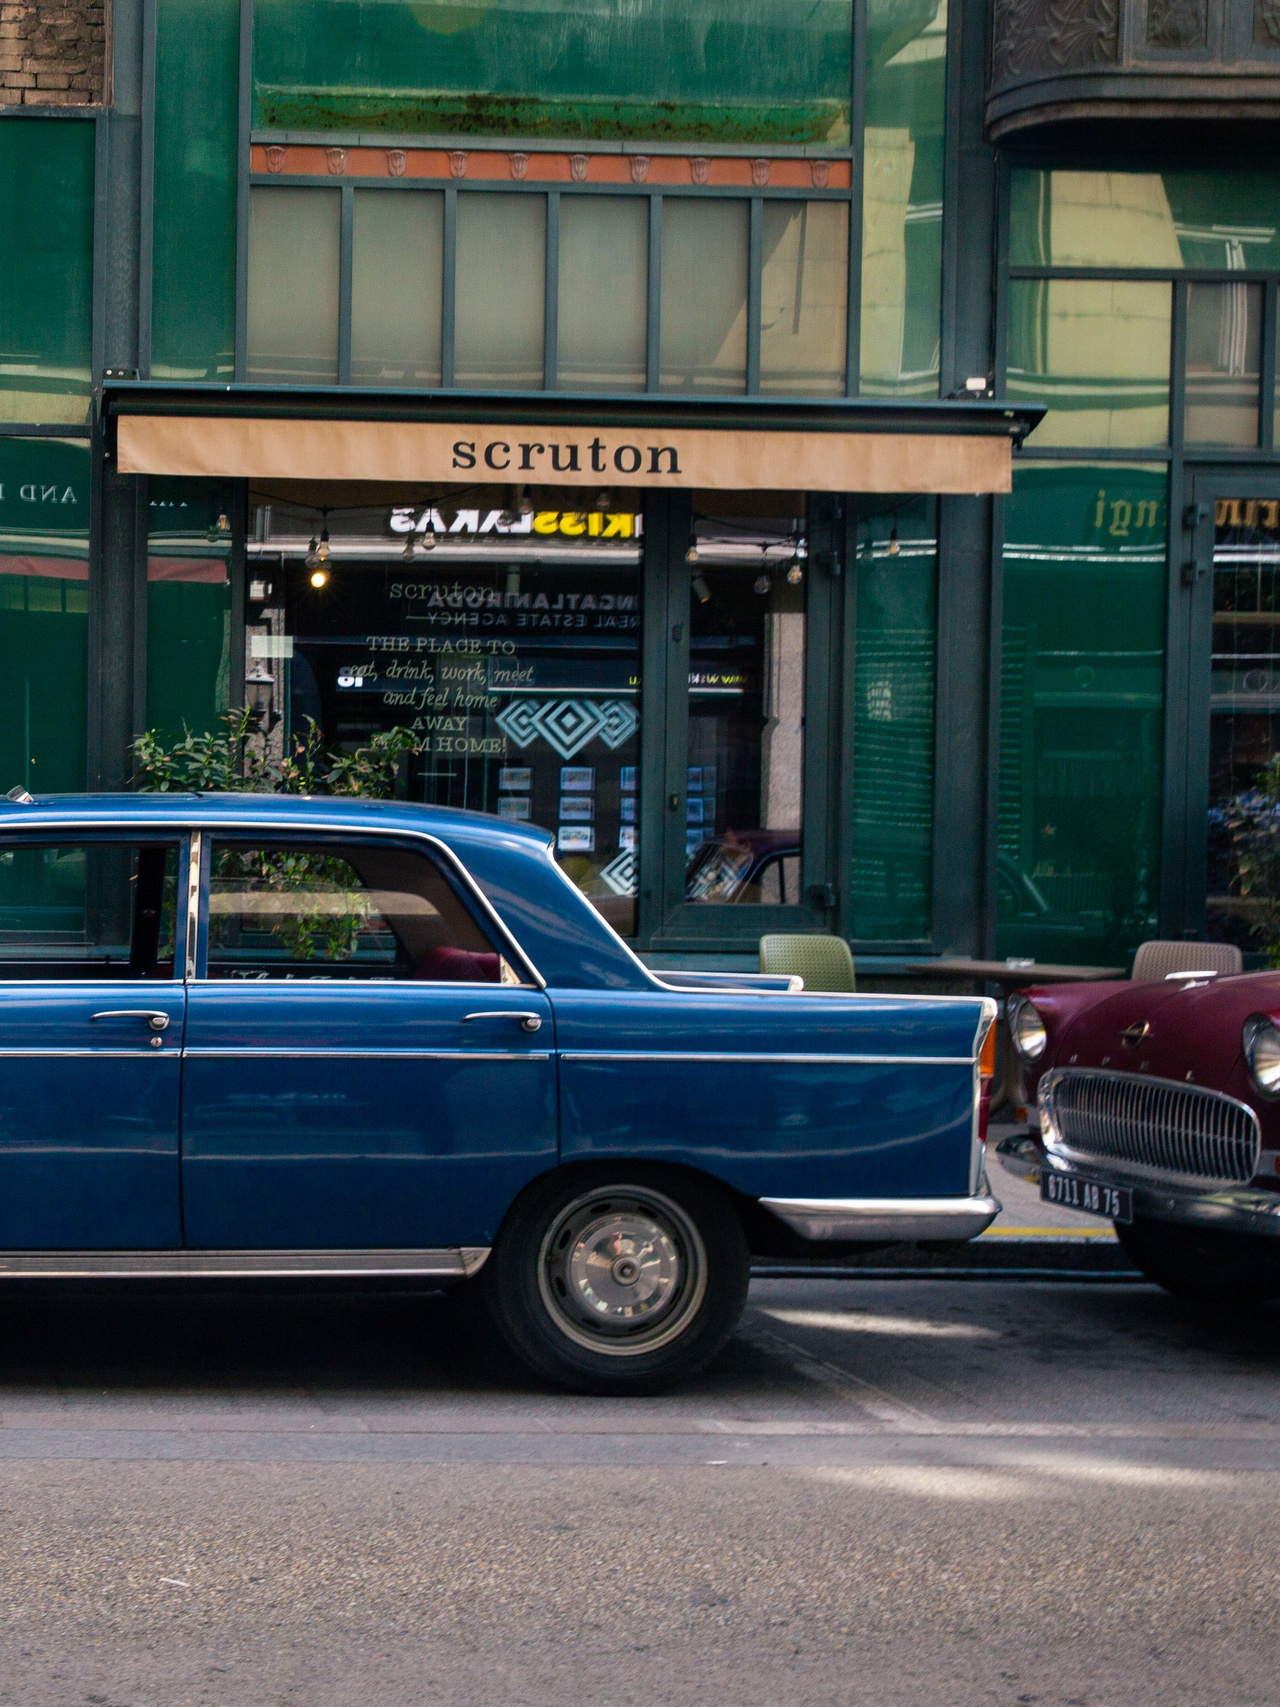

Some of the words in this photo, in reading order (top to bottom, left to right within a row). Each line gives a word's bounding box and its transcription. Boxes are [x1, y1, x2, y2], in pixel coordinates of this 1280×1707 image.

[452, 437, 682, 474] scruton
[389, 580, 496, 602] scruton
[366, 636, 410, 652] THE
[416, 637, 482, 654] PLACE
[486, 640, 516, 656] TO
[385, 659, 435, 684] drink,
[441, 661, 488, 686] work,
[493, 665, 534, 683] meet
[382, 687, 416, 706] and
[418, 688, 449, 710] feel
[454, 687, 498, 709] home
[410, 716, 468, 731] AWAY
[1103, 1187, 1121, 1218] 75
